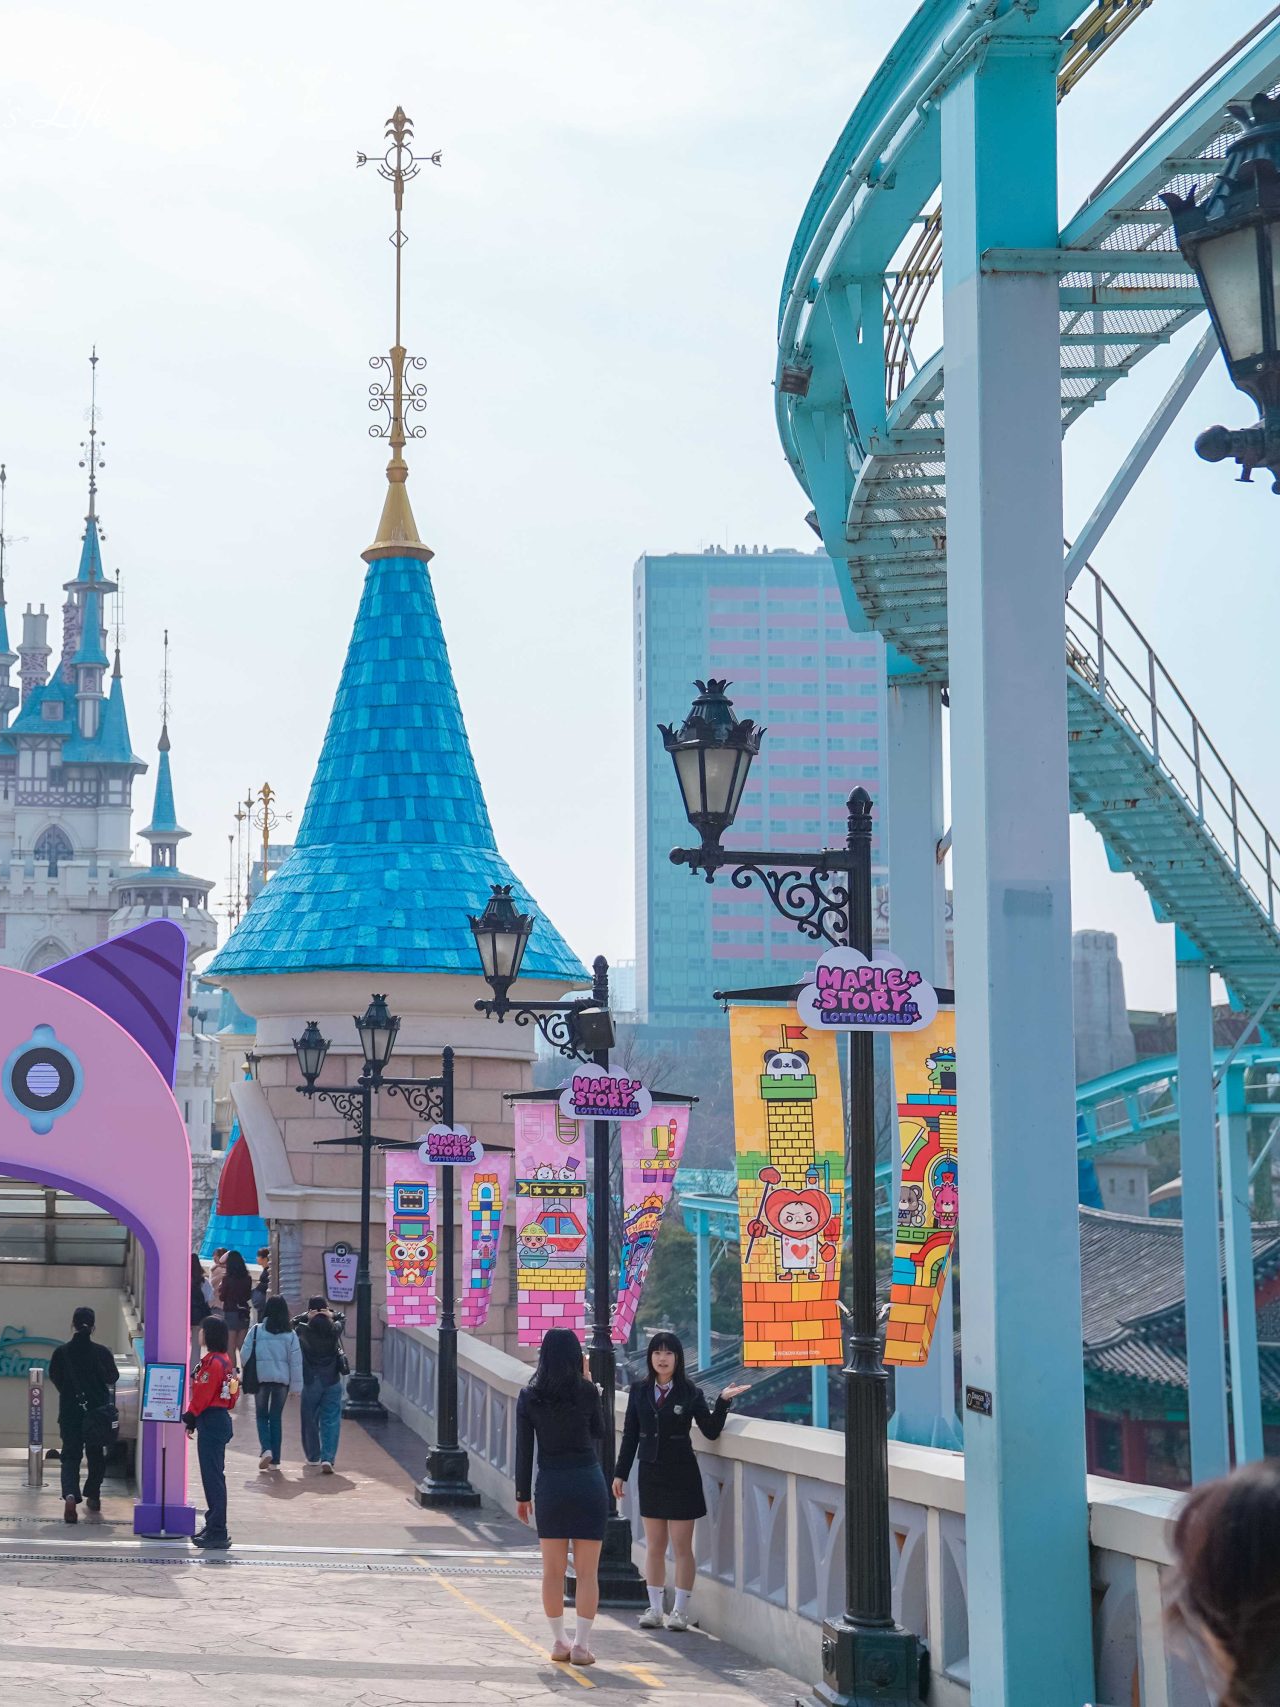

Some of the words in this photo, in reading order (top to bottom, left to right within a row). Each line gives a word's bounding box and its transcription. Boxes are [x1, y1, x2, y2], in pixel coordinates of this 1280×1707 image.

[817, 966, 910, 991] MAPLE
[820, 988, 911, 1012] STORY
[904, 1003, 917, 1012] IN
[821, 1012, 912, 1024] LOTTEWORLD
[572, 1076, 634, 1093] MAPLE
[574, 1092, 634, 1108] STORY
[575, 1107, 635, 1116] LOTTEWORLD
[428, 1133, 470, 1146] MAPLE
[429, 1144, 471, 1156] STORY
